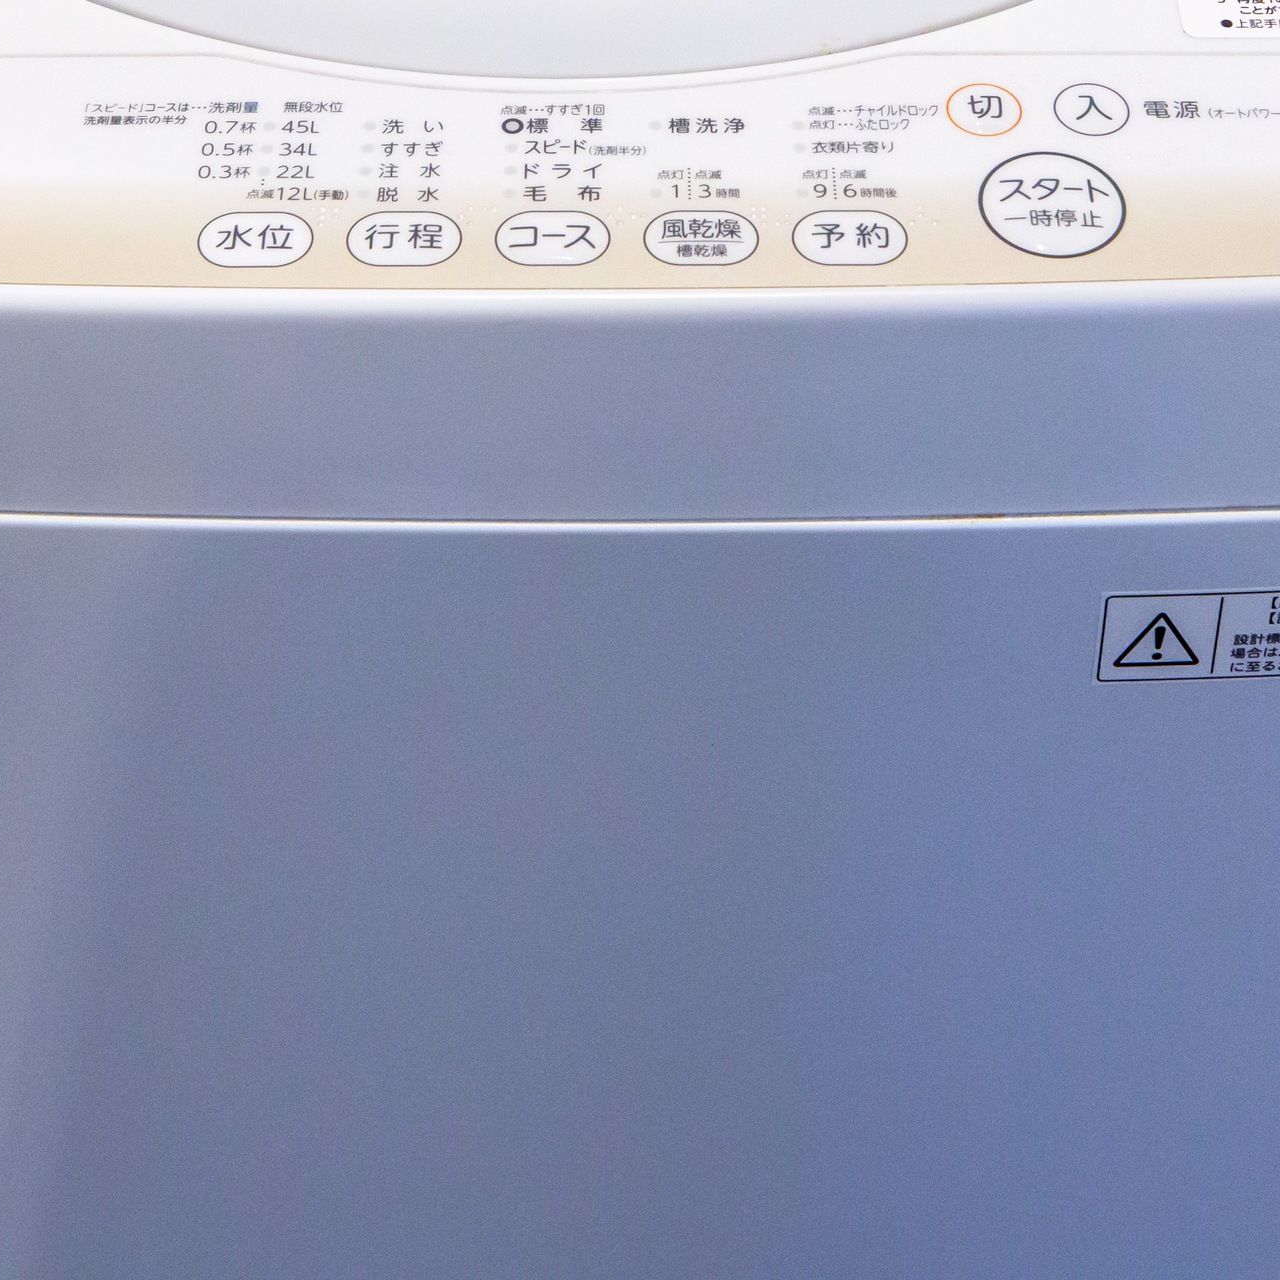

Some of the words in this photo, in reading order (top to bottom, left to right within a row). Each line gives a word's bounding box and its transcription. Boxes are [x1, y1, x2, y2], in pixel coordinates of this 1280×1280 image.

[283, 101, 344, 114] 無段水位
[967, 94, 1003, 119] 切
[1076, 95, 1113, 121] 入
[1143, 100, 1201, 119] 電源
[83, 115, 188, 126] 洗剤量表示の半分
[204, 120, 257, 135] 0.7杯
[281, 120, 320, 135] 45L
[382, 119, 444, 135] 洗い
[526, 117, 603, 134] 標準
[668, 117, 745, 134] 槽洗浄
[201, 142, 254, 157] 0.5杯
[278, 142, 318, 157] 34L
[381, 141, 444, 157] すすぎ
[811, 140, 895, 154] 衣類片寄り
[198, 165, 252, 179] 0.3杯
[276, 165, 315, 179] 22L
[378, 163, 441, 179] 注水
[523, 163, 602, 180] ドライ
[657, 169, 684, 180] 点灯
[694, 169, 723, 180] 点滅
[802, 169, 829, 180] 点灯
[839, 169, 867, 180] 点滅
[376, 186, 440, 203] 脱水
[523, 185, 603, 202] 毛布
[671, 184, 680, 199] 1
[813, 183, 827, 199] 9
[999, 177, 1110, 203] スタート
[1003, 208, 1105, 229] 一時停止
[215, 223, 295, 251] 水位
[364, 222, 444, 251] 行程
[508, 223, 598, 251] コース
[661, 218, 743, 240] 風乾燥
[810, 221, 891, 251] 予約
[676, 243, 728, 258] 槽乾燥
